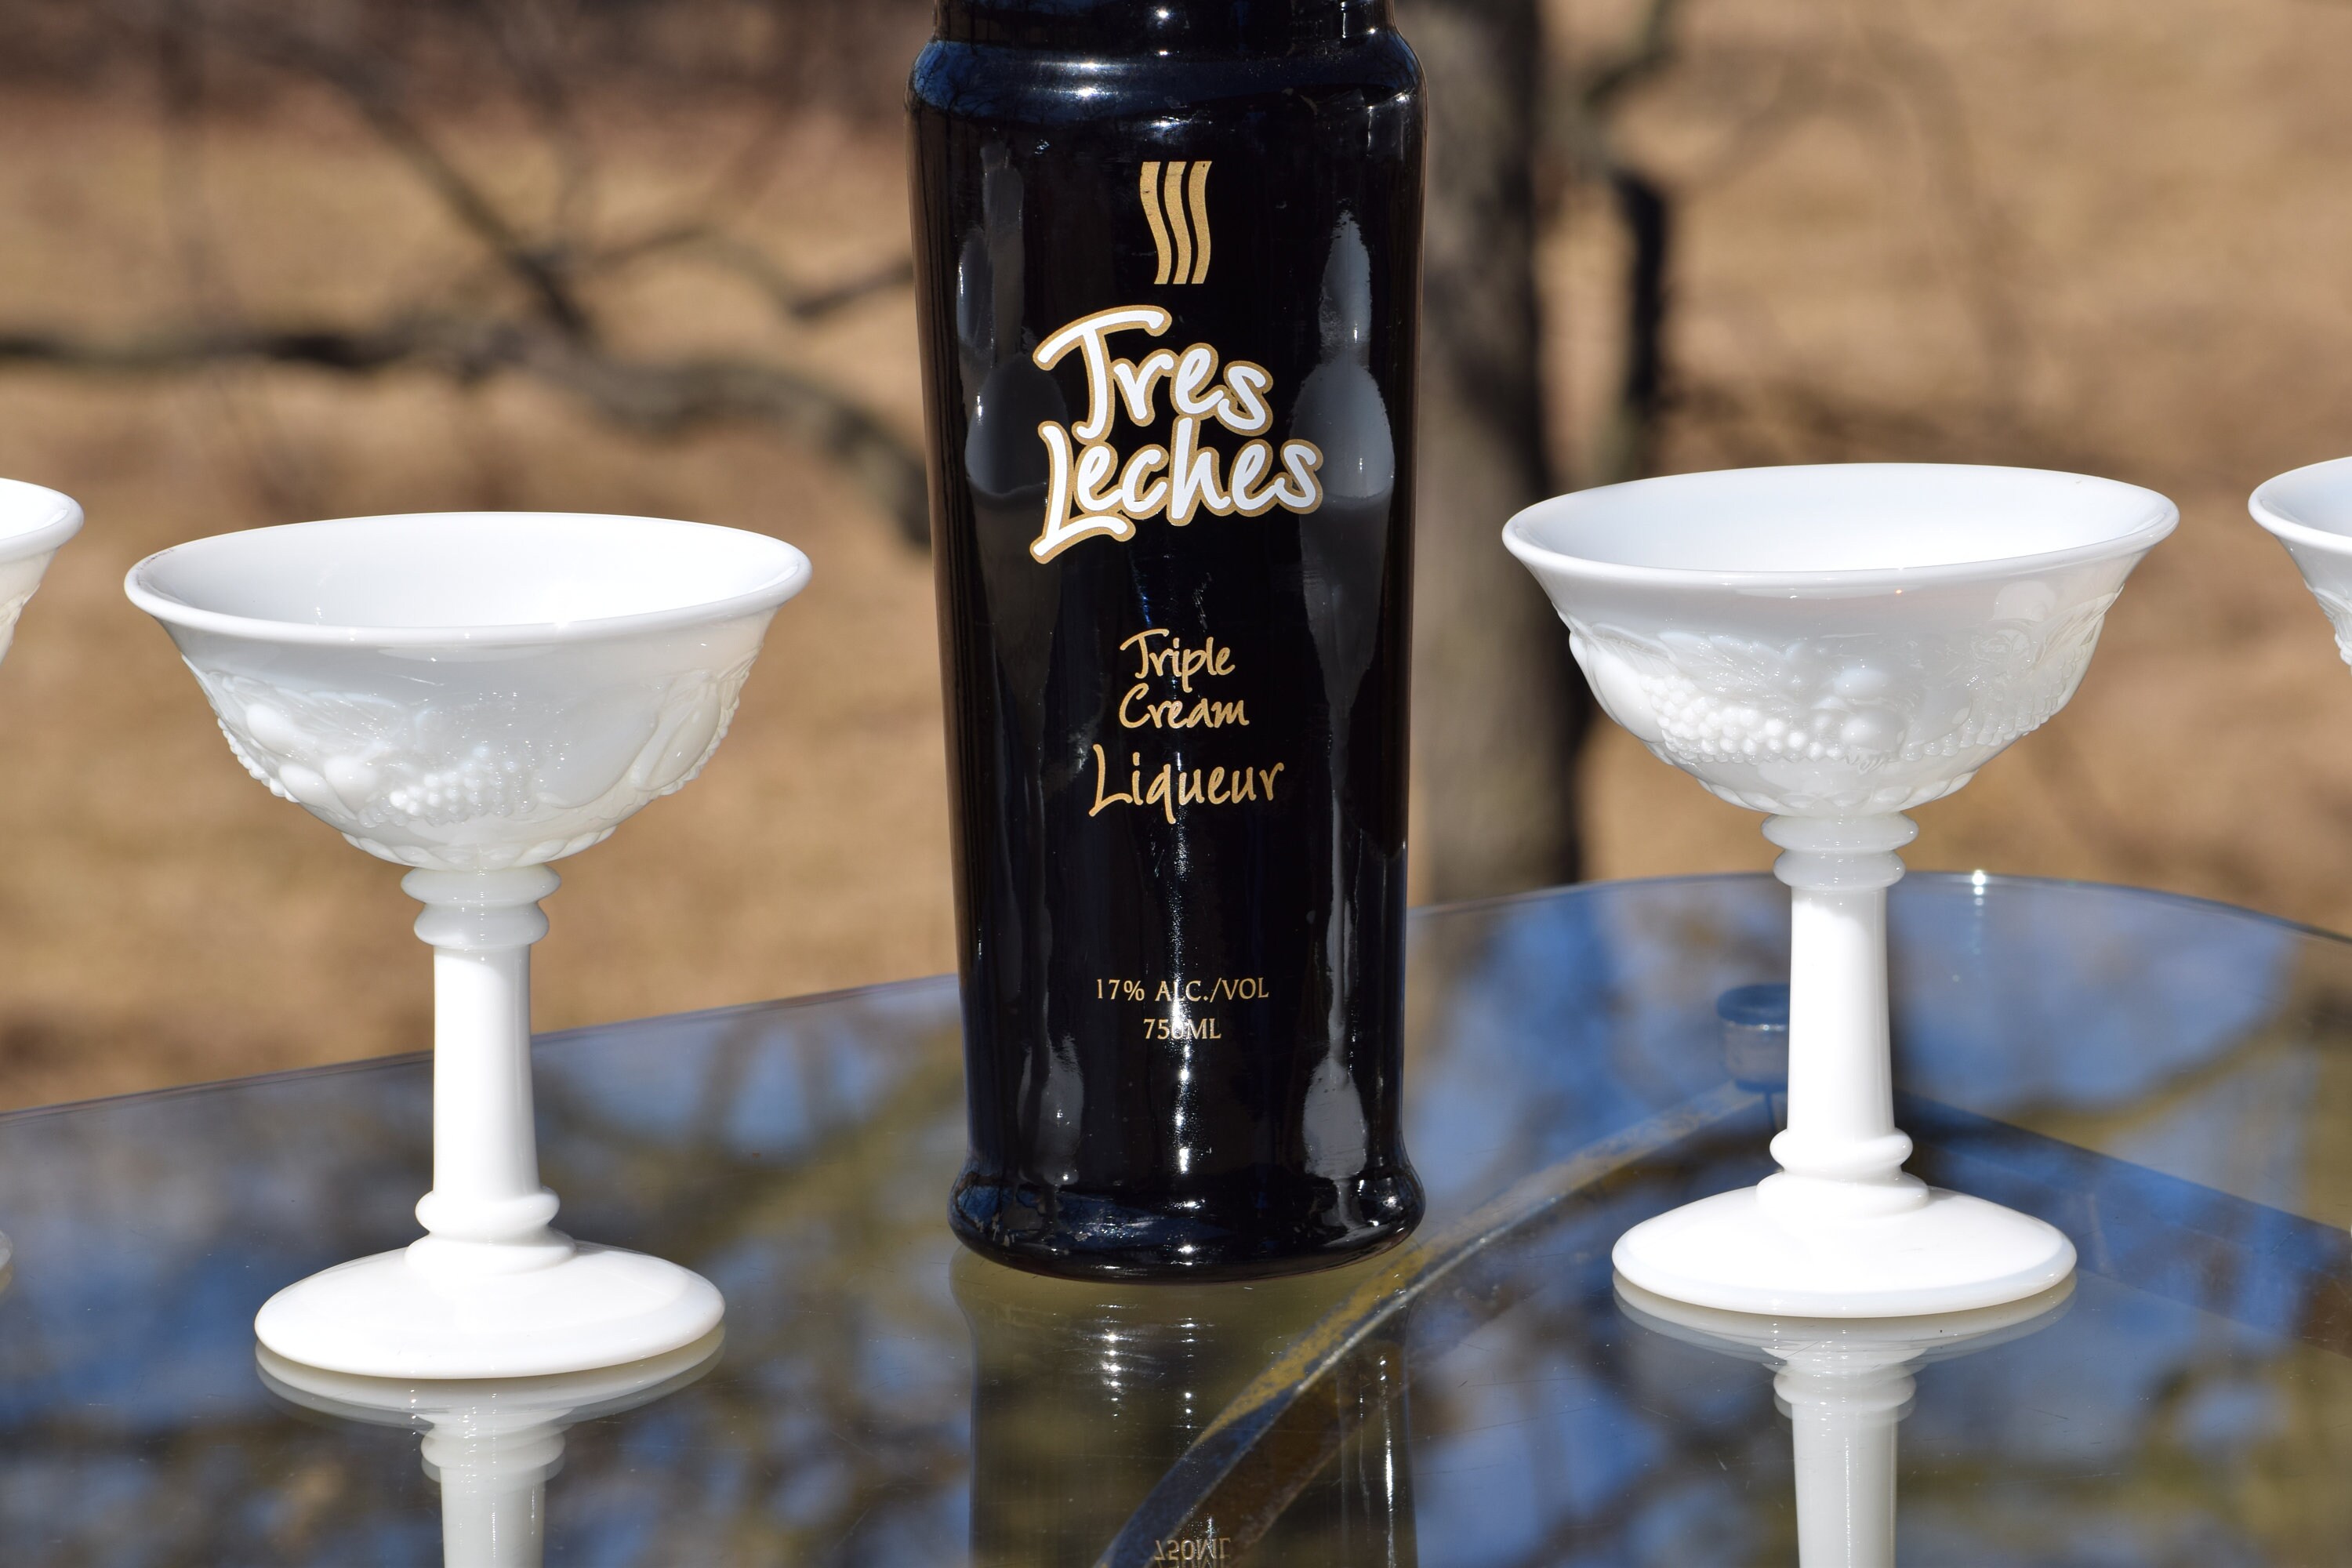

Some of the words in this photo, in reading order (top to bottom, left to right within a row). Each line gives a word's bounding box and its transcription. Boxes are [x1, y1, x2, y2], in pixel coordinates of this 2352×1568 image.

[1033, 305, 1273, 445] Tres
[1030, 412, 1323, 564] Leches
[1120, 629, 1236, 693] Triple
[1119, 683, 1250, 728] Cream
[1088, 744, 1284, 825] Liqueur
[1097, 978, 1145, 1001] 17%
[1155, 977, 1269, 1003] ALC./VOL
